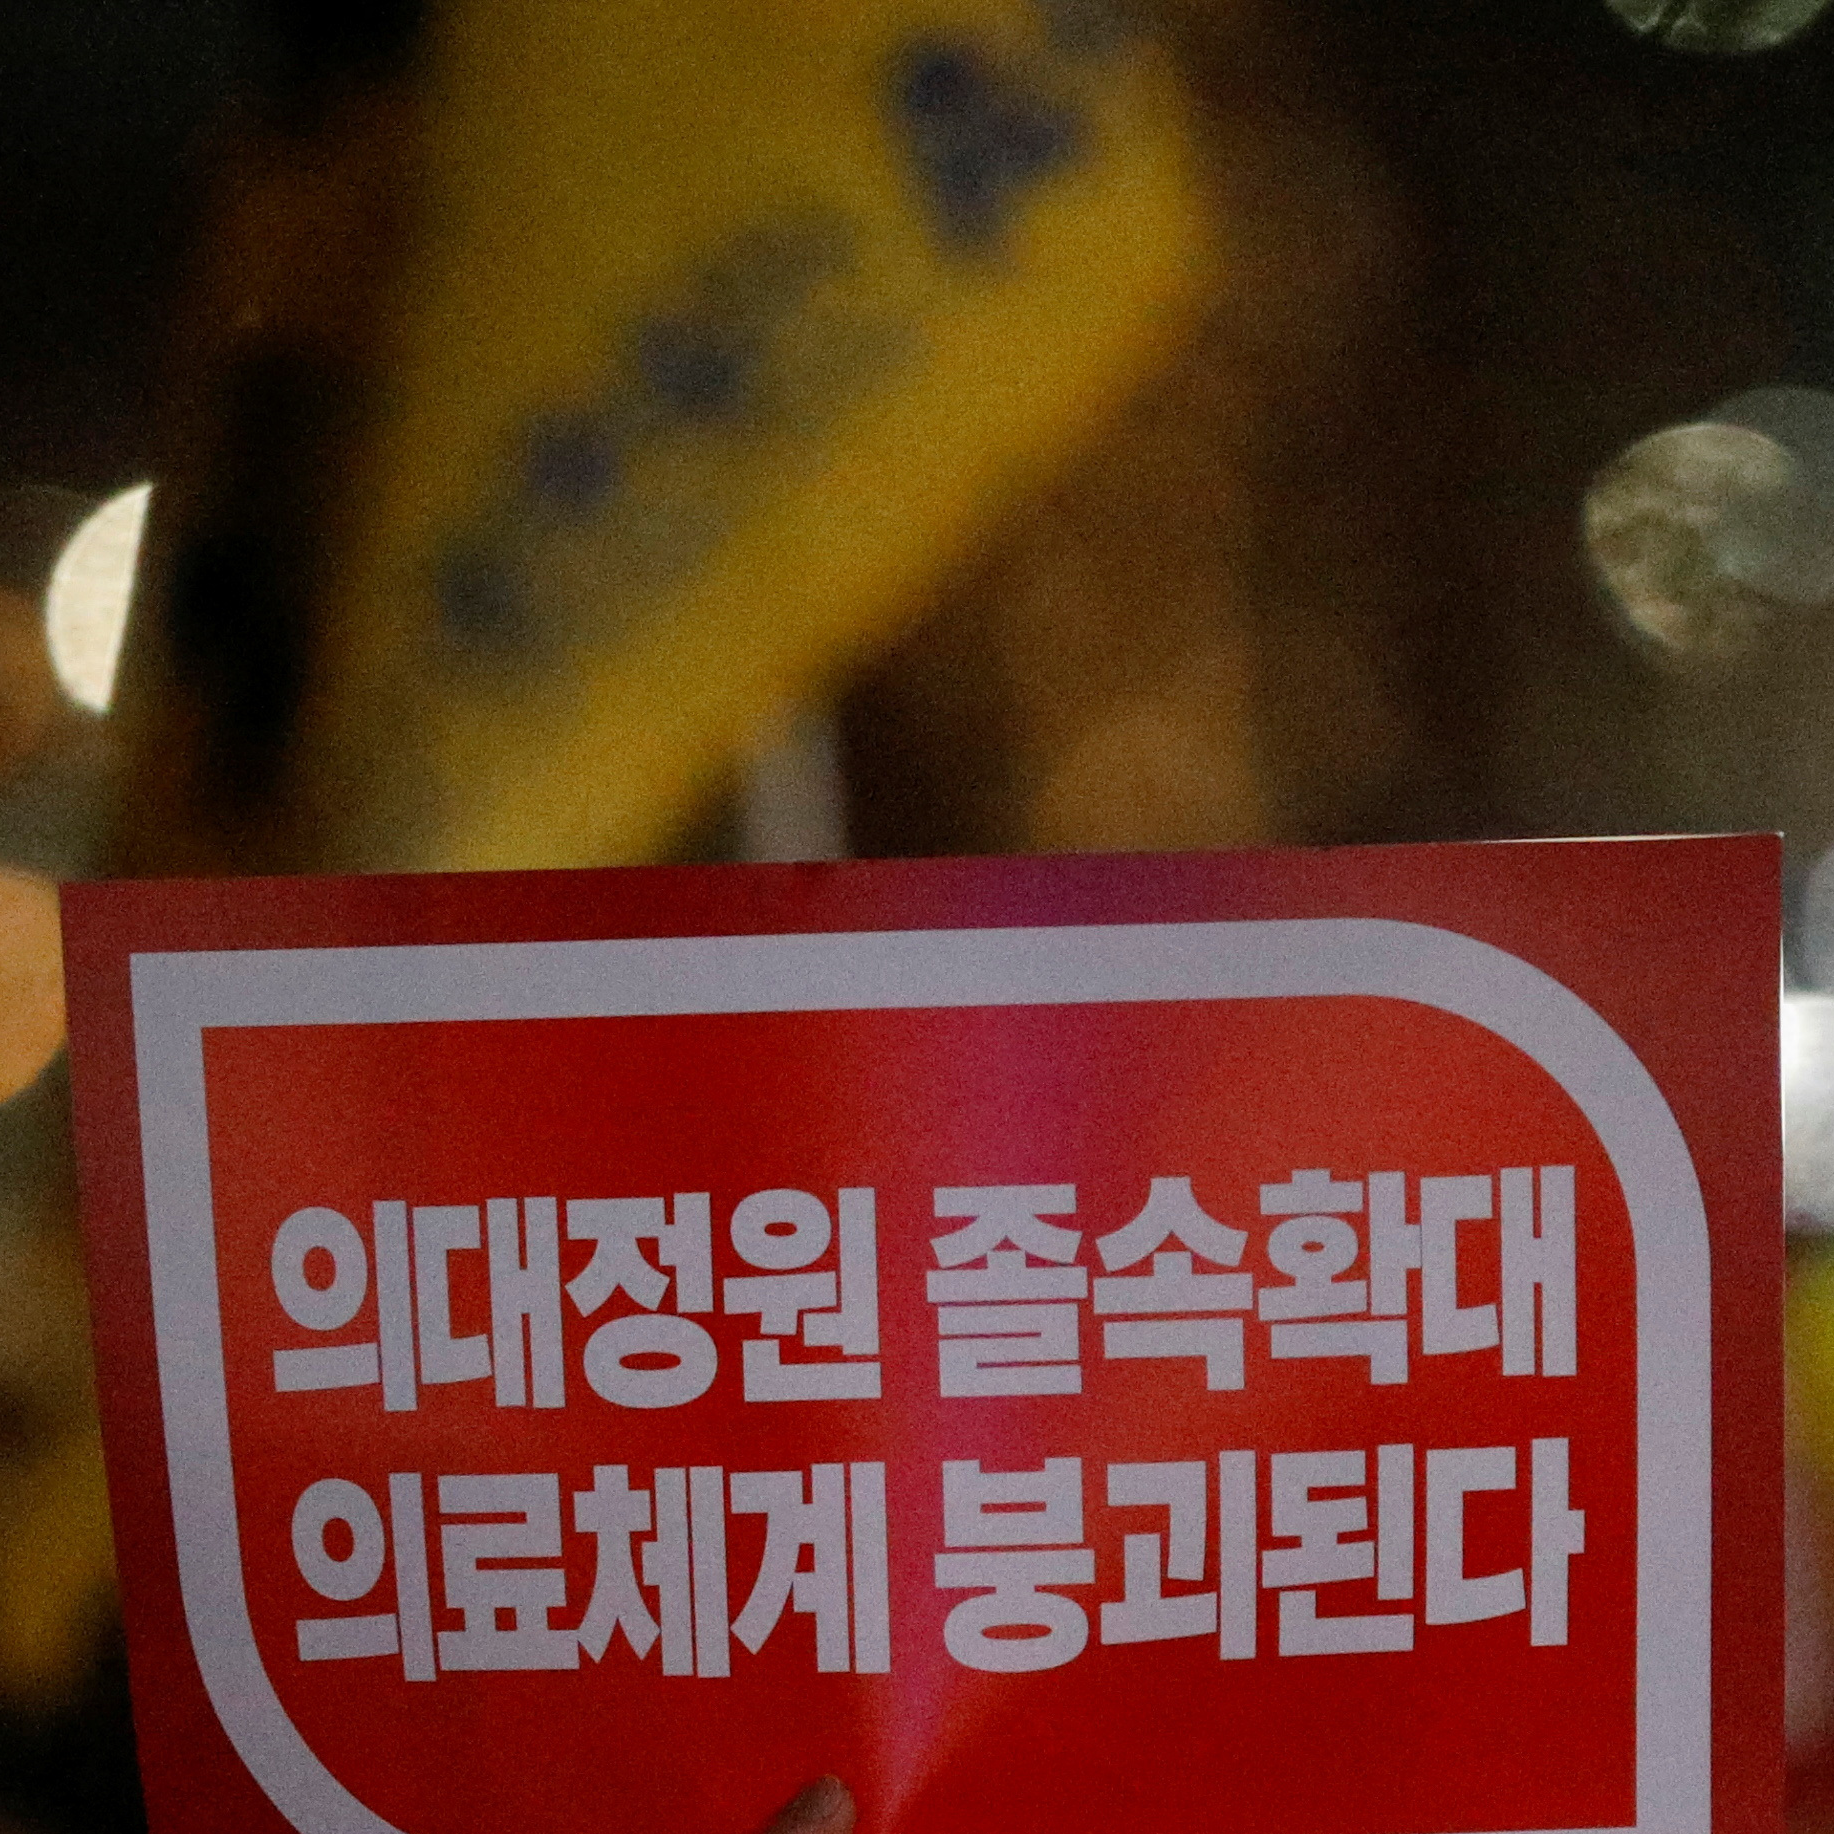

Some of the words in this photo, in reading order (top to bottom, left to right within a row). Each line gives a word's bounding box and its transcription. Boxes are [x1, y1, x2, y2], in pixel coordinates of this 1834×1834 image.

[270, 1186, 882, 1413] 의대정원
[925, 1164, 1578, 1399] 졸속확대
[291, 1460, 891, 1682] 의료체계
[933, 1436, 1585, 1673] 붕괴된다
